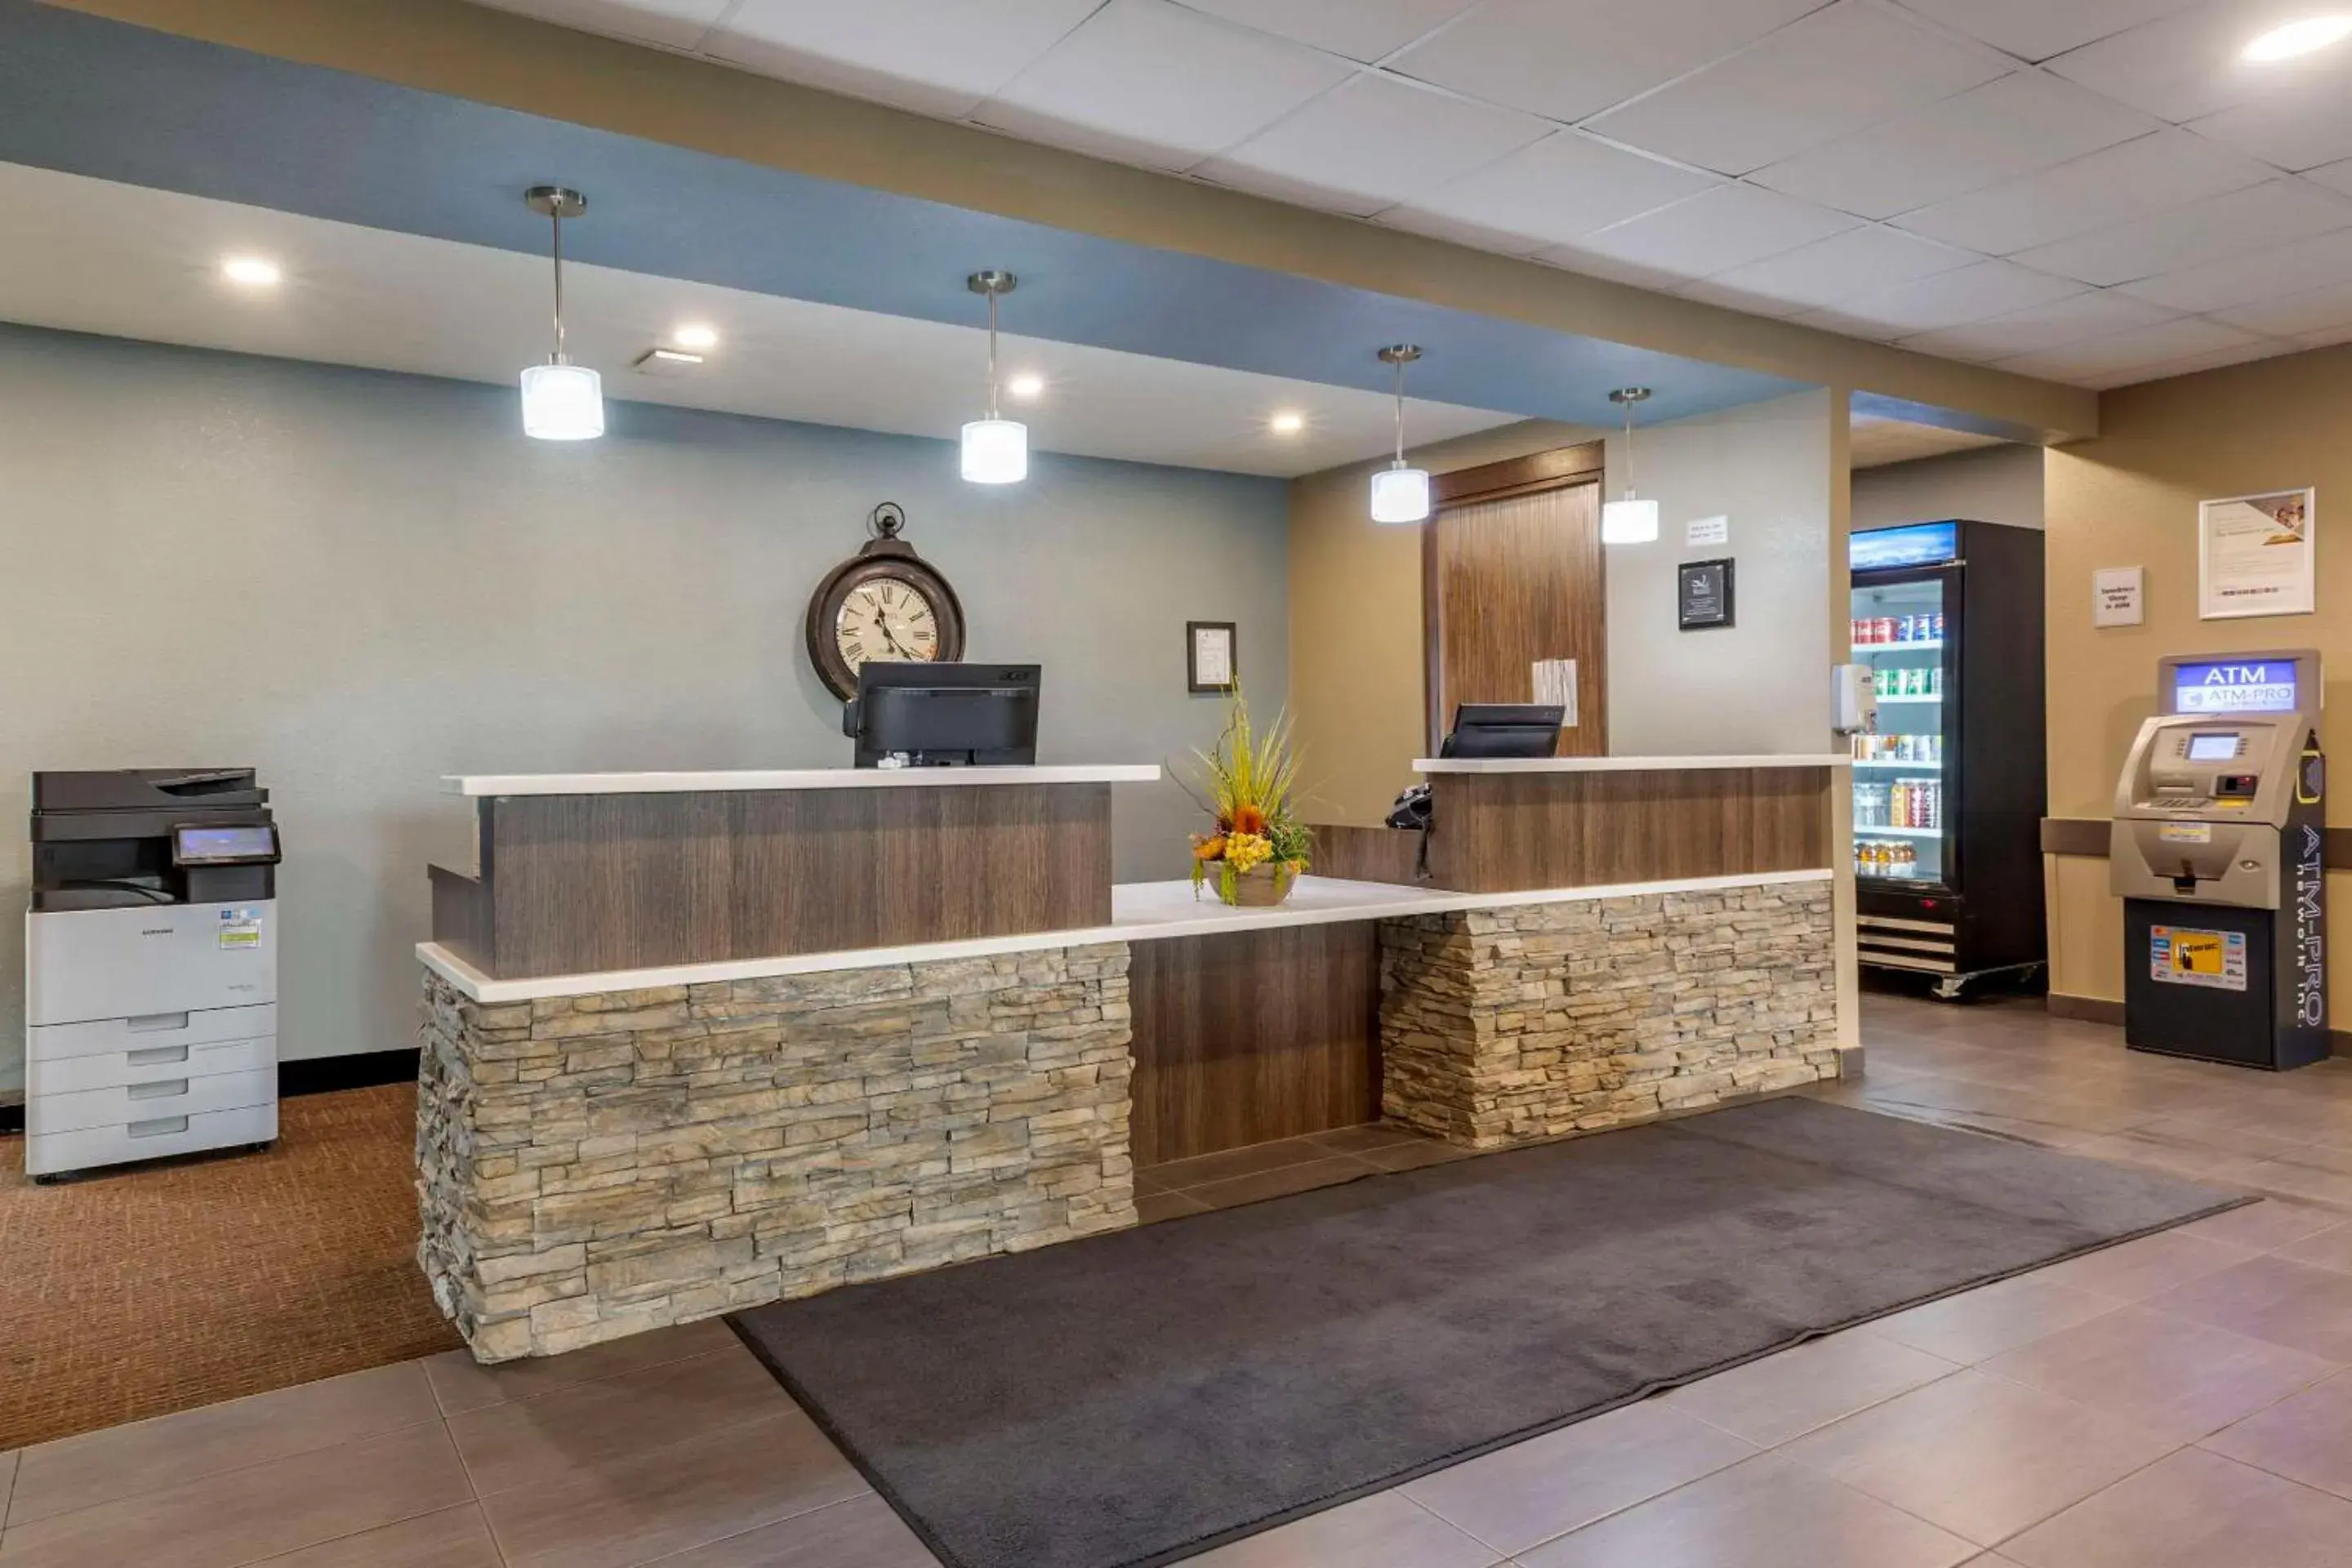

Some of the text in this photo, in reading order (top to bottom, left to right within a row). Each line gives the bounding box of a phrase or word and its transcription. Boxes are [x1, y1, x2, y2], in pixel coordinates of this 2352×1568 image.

[2205, 666, 2265, 684] ATM
[2209, 687, 2292, 702] ATM-PRO
[2302, 824, 2323, 1027] ATM-PRO
